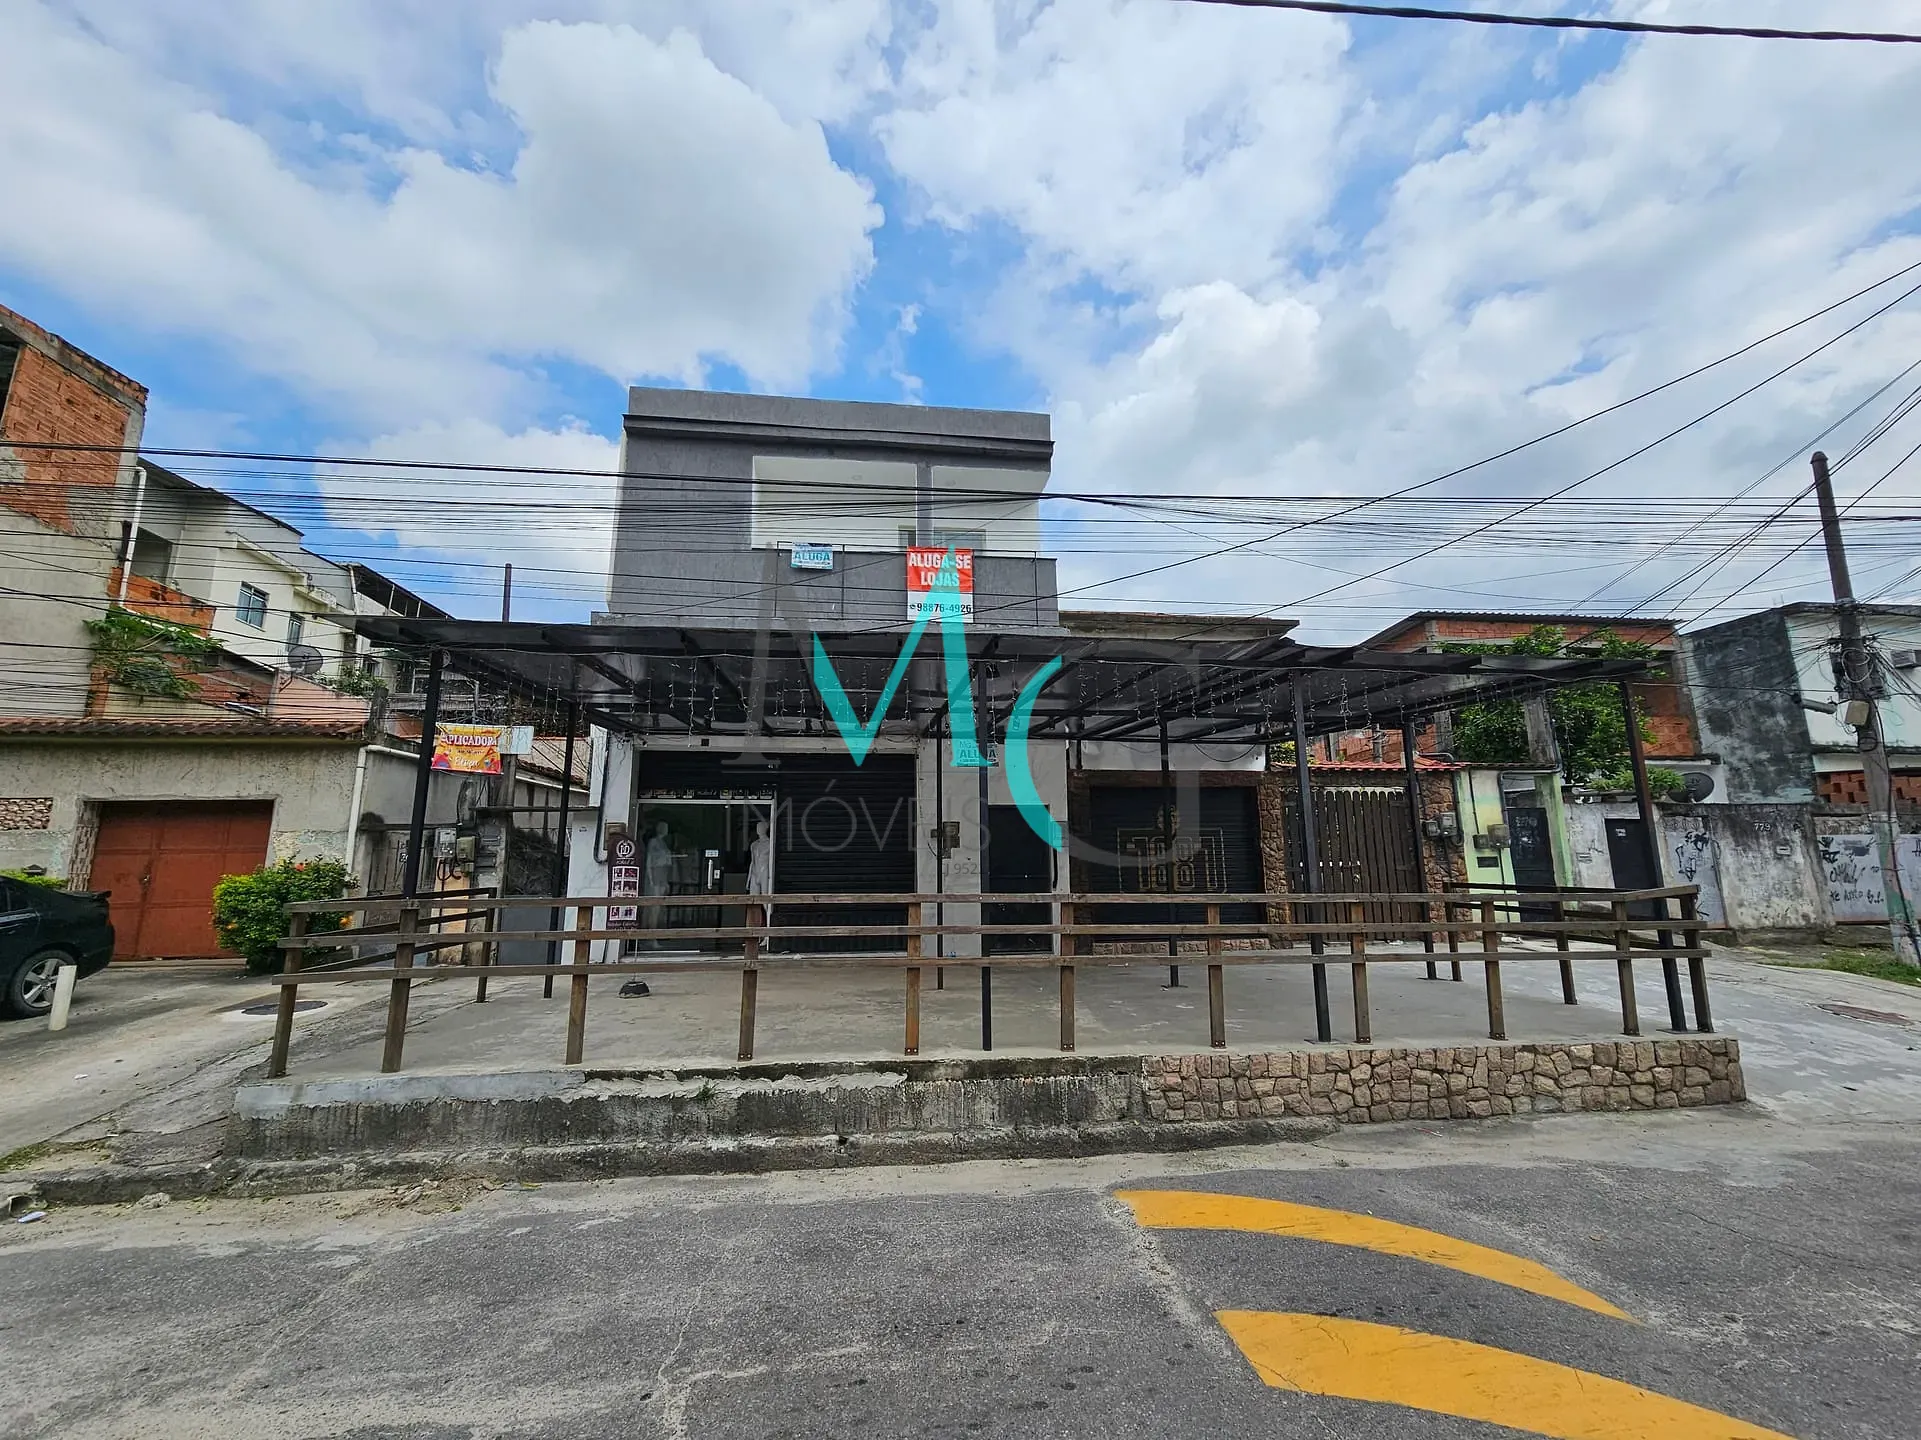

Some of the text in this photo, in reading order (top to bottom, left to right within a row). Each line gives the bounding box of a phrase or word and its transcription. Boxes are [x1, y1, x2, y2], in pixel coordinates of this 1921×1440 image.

[794, 551, 830, 561] ALUGA
[909, 552, 971, 569] ALUGA-SE
[920, 571, 960, 586] LOJAS
[917, 602, 972, 613] 98876-4926
[1753, 823, 1771, 831] 779
